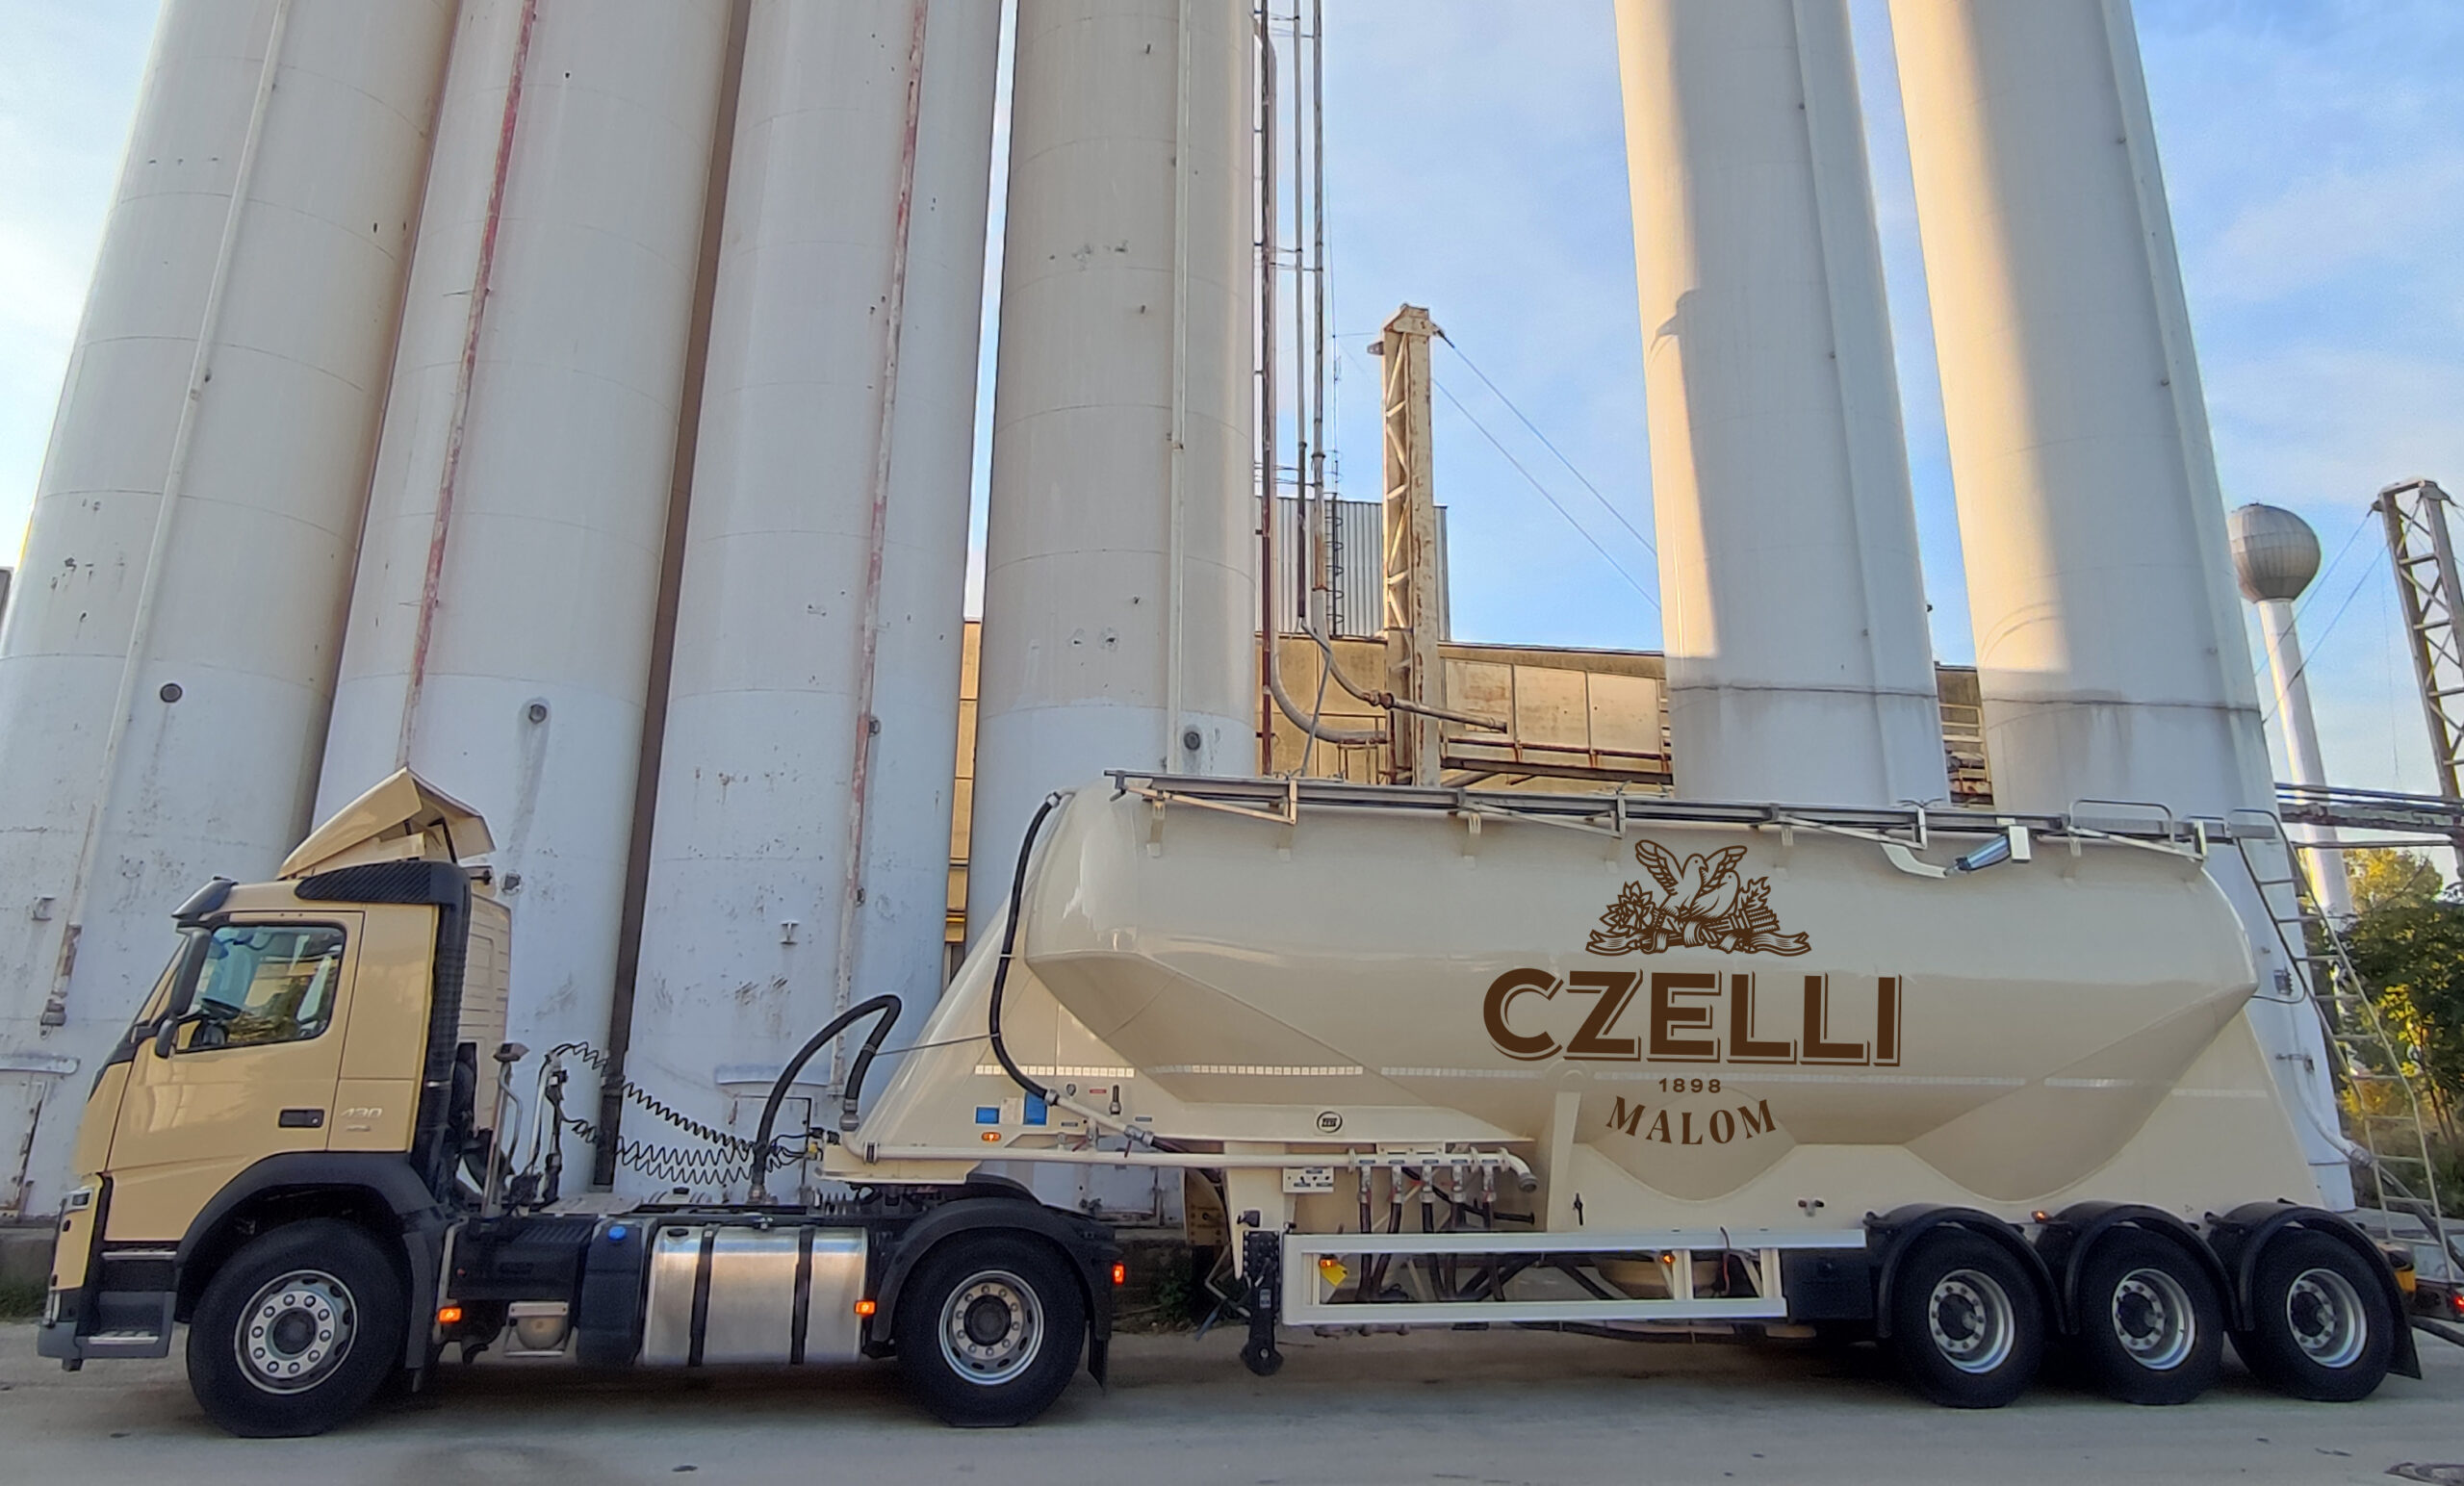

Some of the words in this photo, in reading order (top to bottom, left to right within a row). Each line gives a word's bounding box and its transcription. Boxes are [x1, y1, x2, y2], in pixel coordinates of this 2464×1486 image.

[1483, 968, 1902, 1066] CZELLI
[1658, 1078, 1721, 1093] 1898
[1605, 1096, 1777, 1145] MALOM
